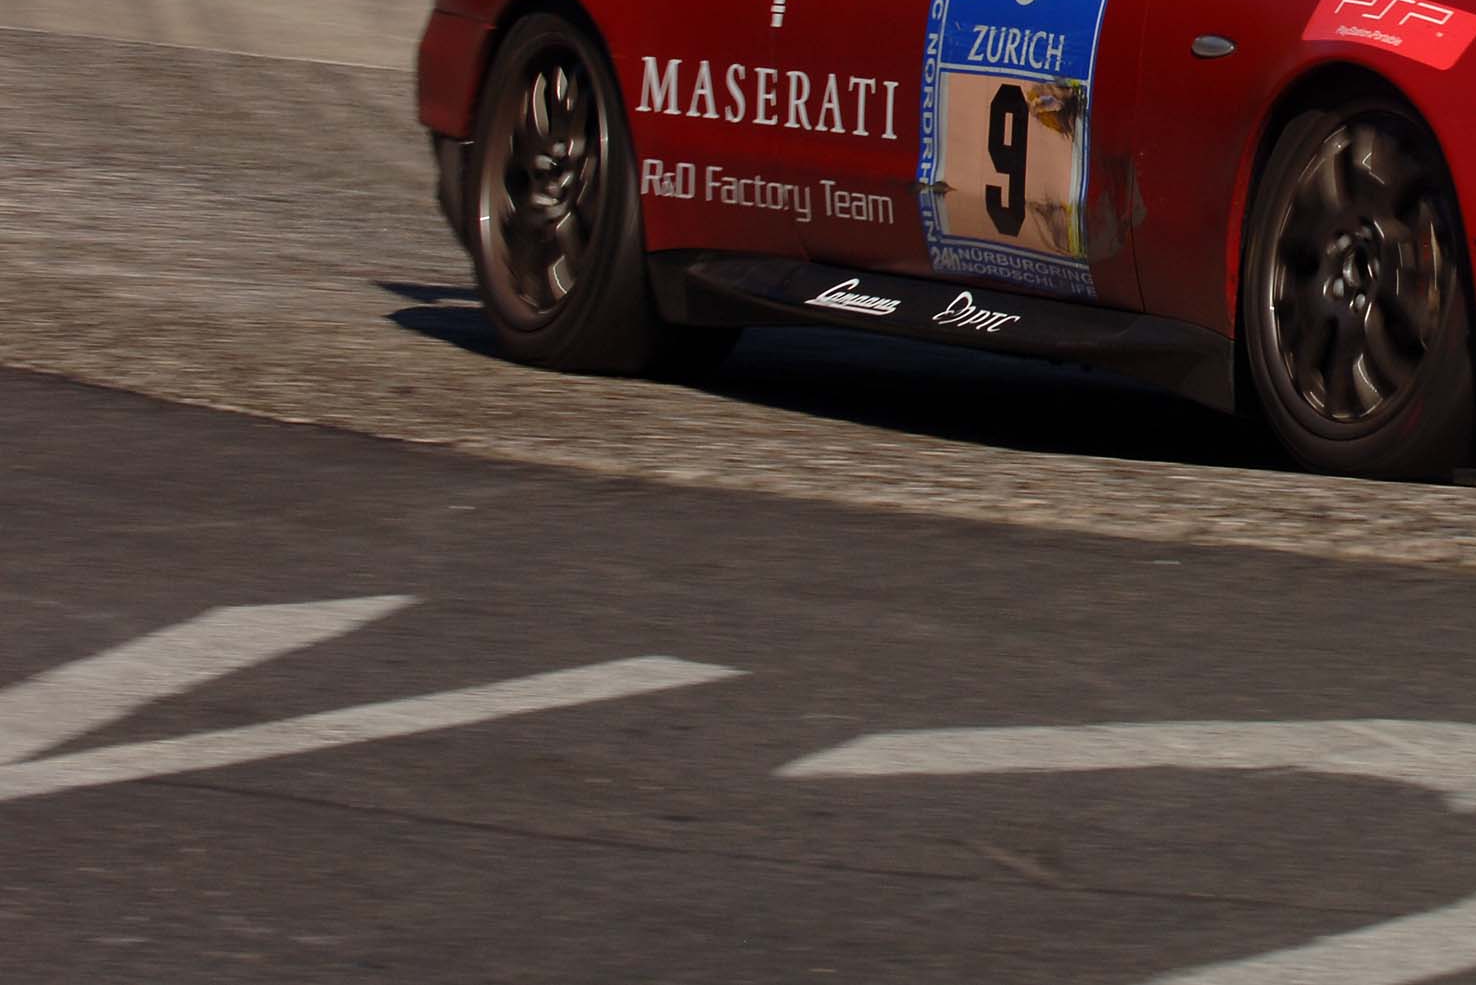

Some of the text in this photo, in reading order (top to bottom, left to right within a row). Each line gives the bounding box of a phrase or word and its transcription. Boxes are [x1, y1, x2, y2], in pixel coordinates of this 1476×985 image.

[635, 56, 899, 139] MASERATI
[640, 159, 894, 224] R&D Factory Team
[985, 83, 1029, 238] 9
[961, 262, 1097, 297] NORDSCHLIFE
